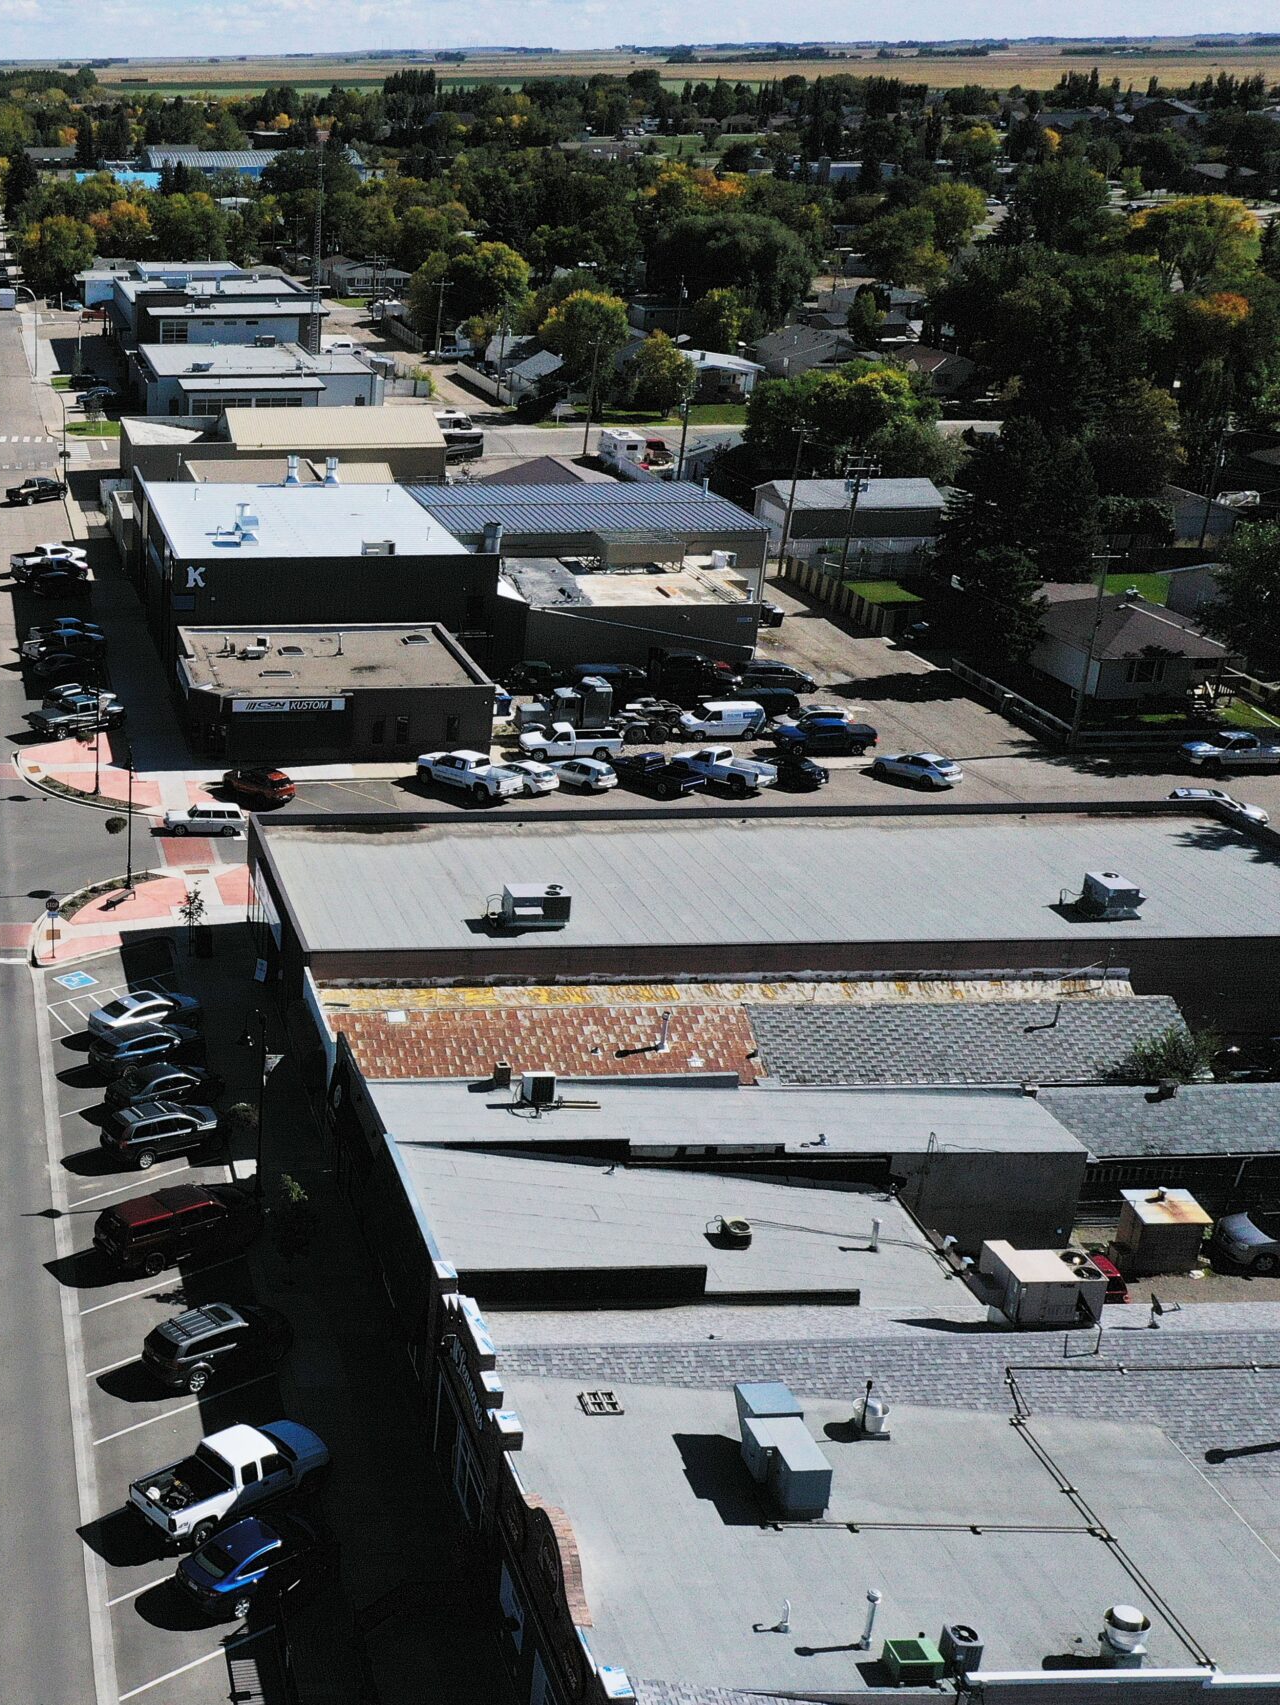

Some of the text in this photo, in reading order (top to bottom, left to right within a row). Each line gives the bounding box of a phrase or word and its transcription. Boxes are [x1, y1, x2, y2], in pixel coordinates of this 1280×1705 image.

[186, 566, 206, 588] K
[255, 701, 329, 710] CSN KUSTOM
